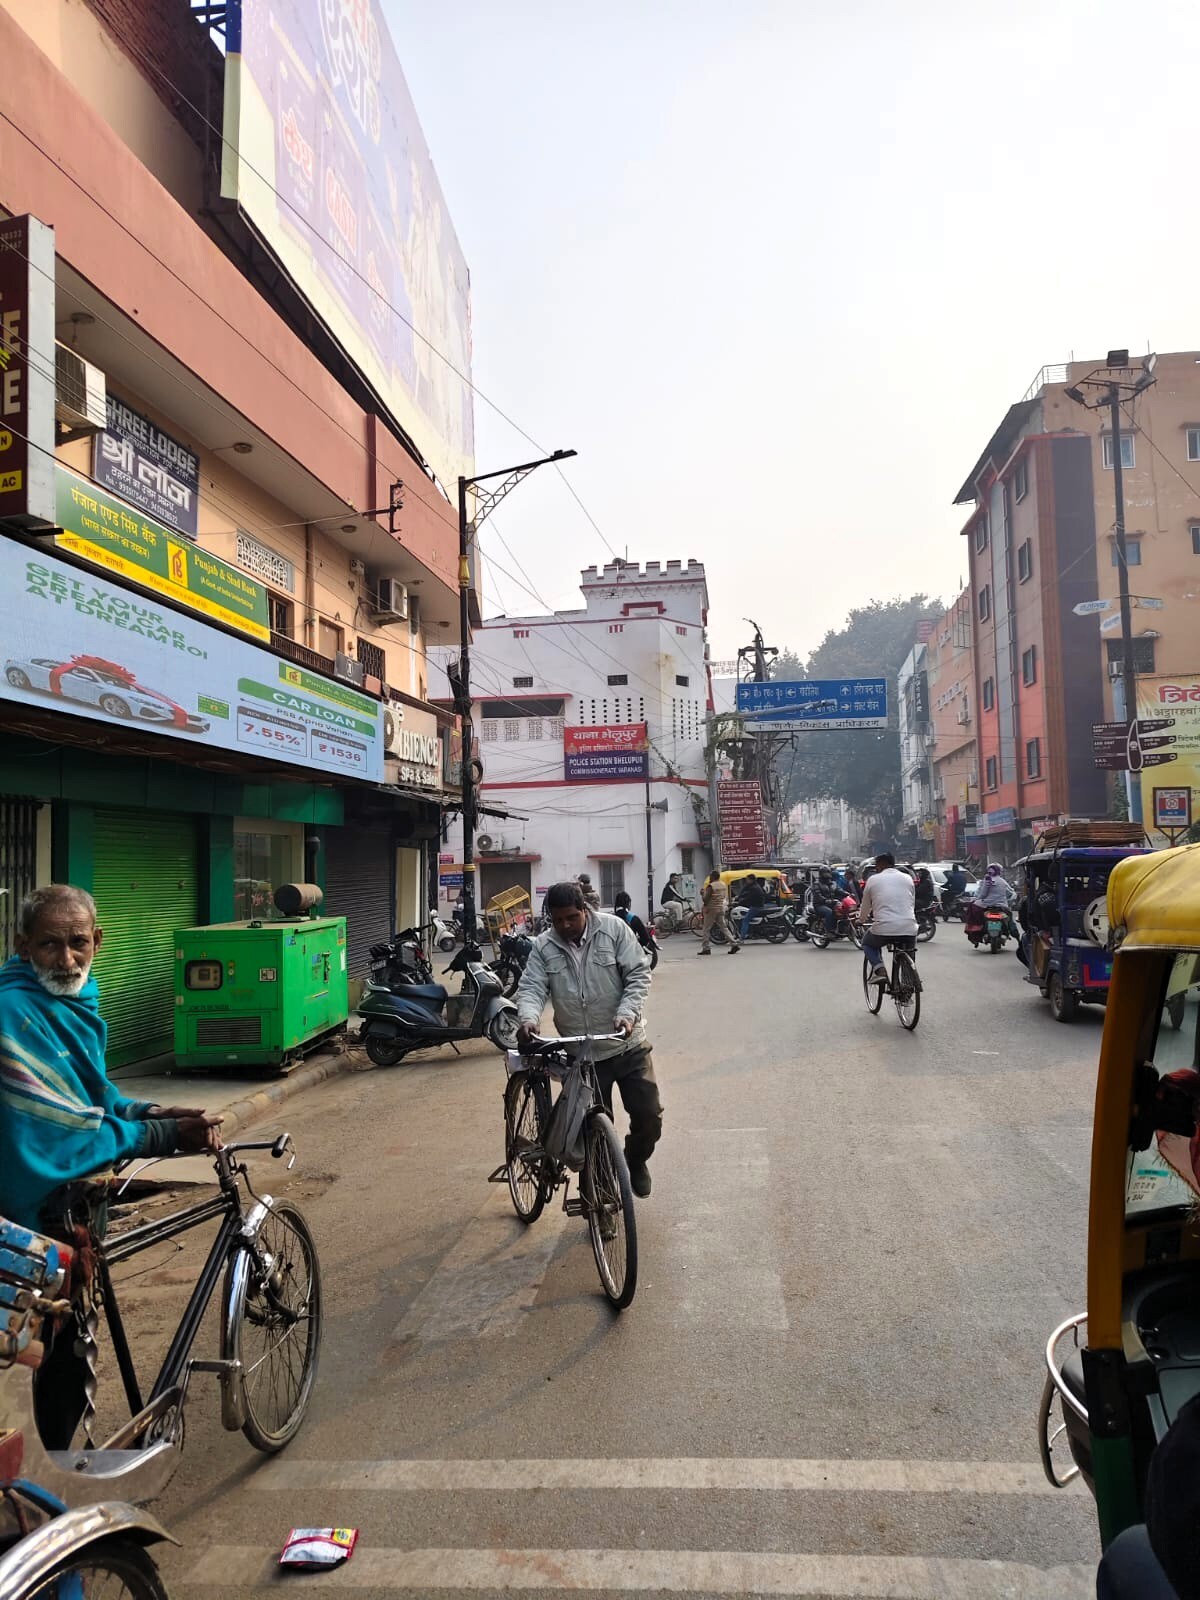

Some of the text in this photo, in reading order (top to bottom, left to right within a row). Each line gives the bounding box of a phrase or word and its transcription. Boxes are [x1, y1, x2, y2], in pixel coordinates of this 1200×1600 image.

[150, 425, 196, 474] LODGE
[2, 475, 17, 487] AC
[102, 432, 192, 512] श्री लॉज
[71, 486, 97, 514] पंजाब
[194, 554, 218, 577] Punjab
[26, 562, 85, 591] GET
[92, 587, 163, 624] YOUR
[26, 572, 130, 621] DREAM
[137, 617, 185, 642] CAR
[26, 586, 208, 660] AT DREAM ROI
[272, 692, 356, 728] CAR LOAN
[400, 726, 439, 767] BIENCE
[573, 727, 637, 743] थाना भेलूपुर
[569, 756, 643, 766] POLICE STATION BHELUPUR
